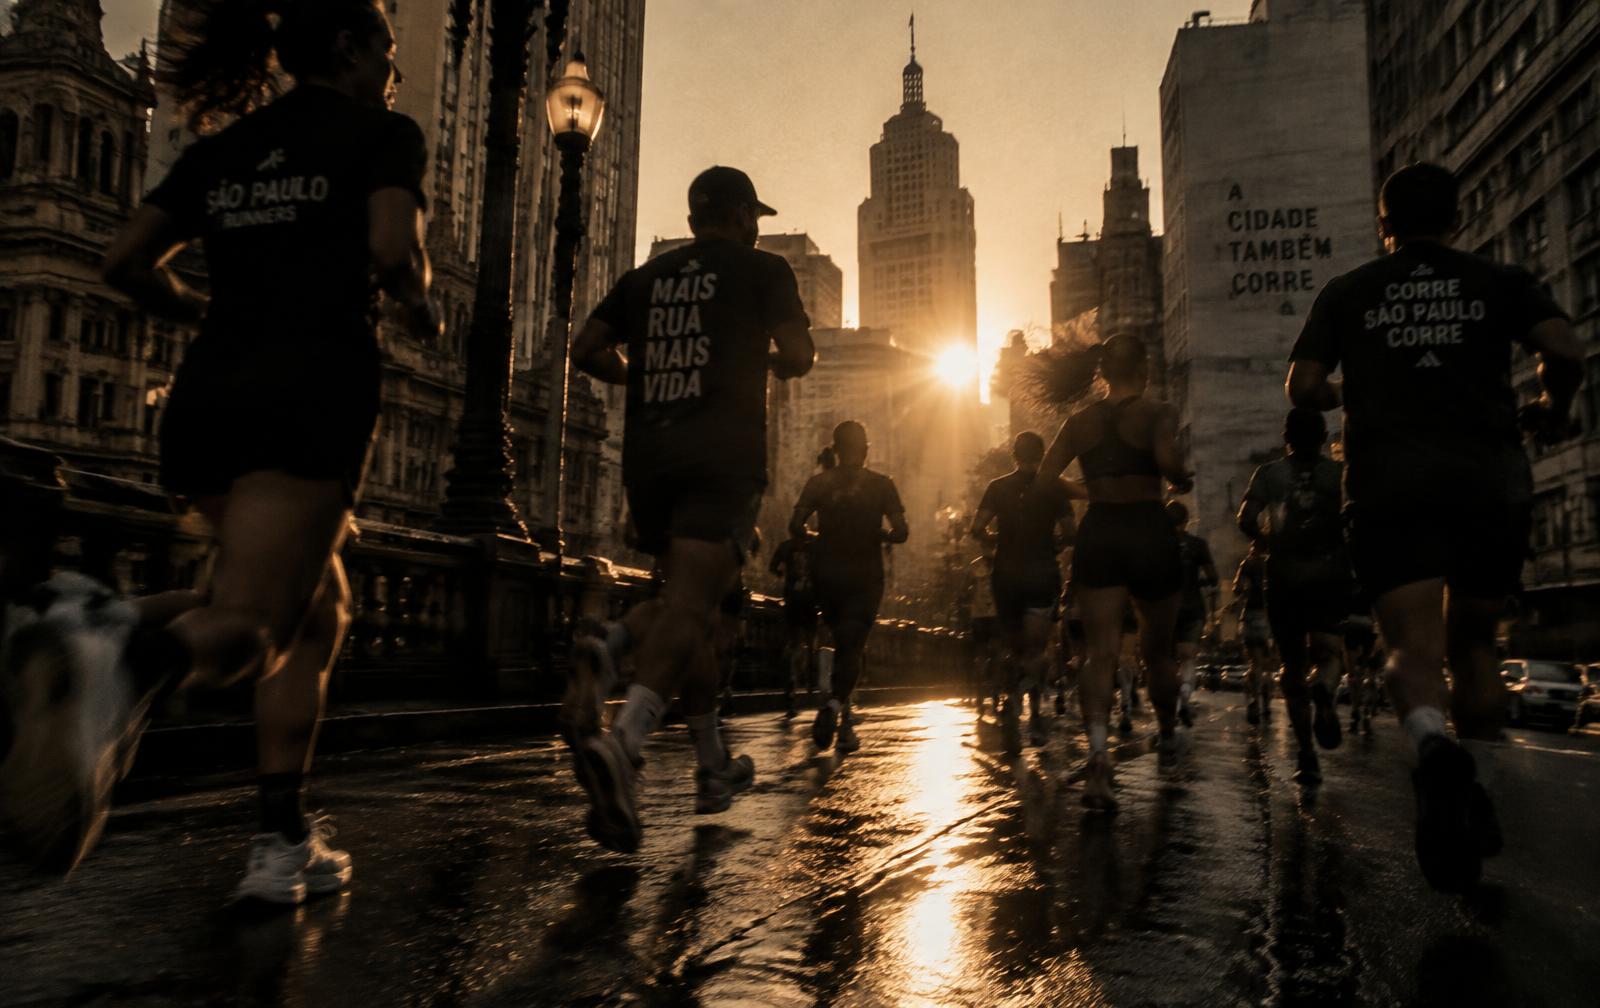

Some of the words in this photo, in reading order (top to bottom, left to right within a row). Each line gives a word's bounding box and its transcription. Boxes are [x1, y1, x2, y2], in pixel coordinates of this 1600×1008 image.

[250, 175, 329, 207] PAULO
[1228, 184, 1242, 200] A
[1228, 207, 1318, 232] CIDADE
[650, 272, 718, 304] MAIS
[1232, 270, 1314, 295] CORRE
[1385, 278, 1462, 301] CORRE
[647, 304, 702, 337] RUA
[1412, 299, 1487, 323] PAULO
[1386, 322, 1465, 348] CORRE
[644, 335, 712, 371] MAIS
[643, 368, 702, 403] VIDA
